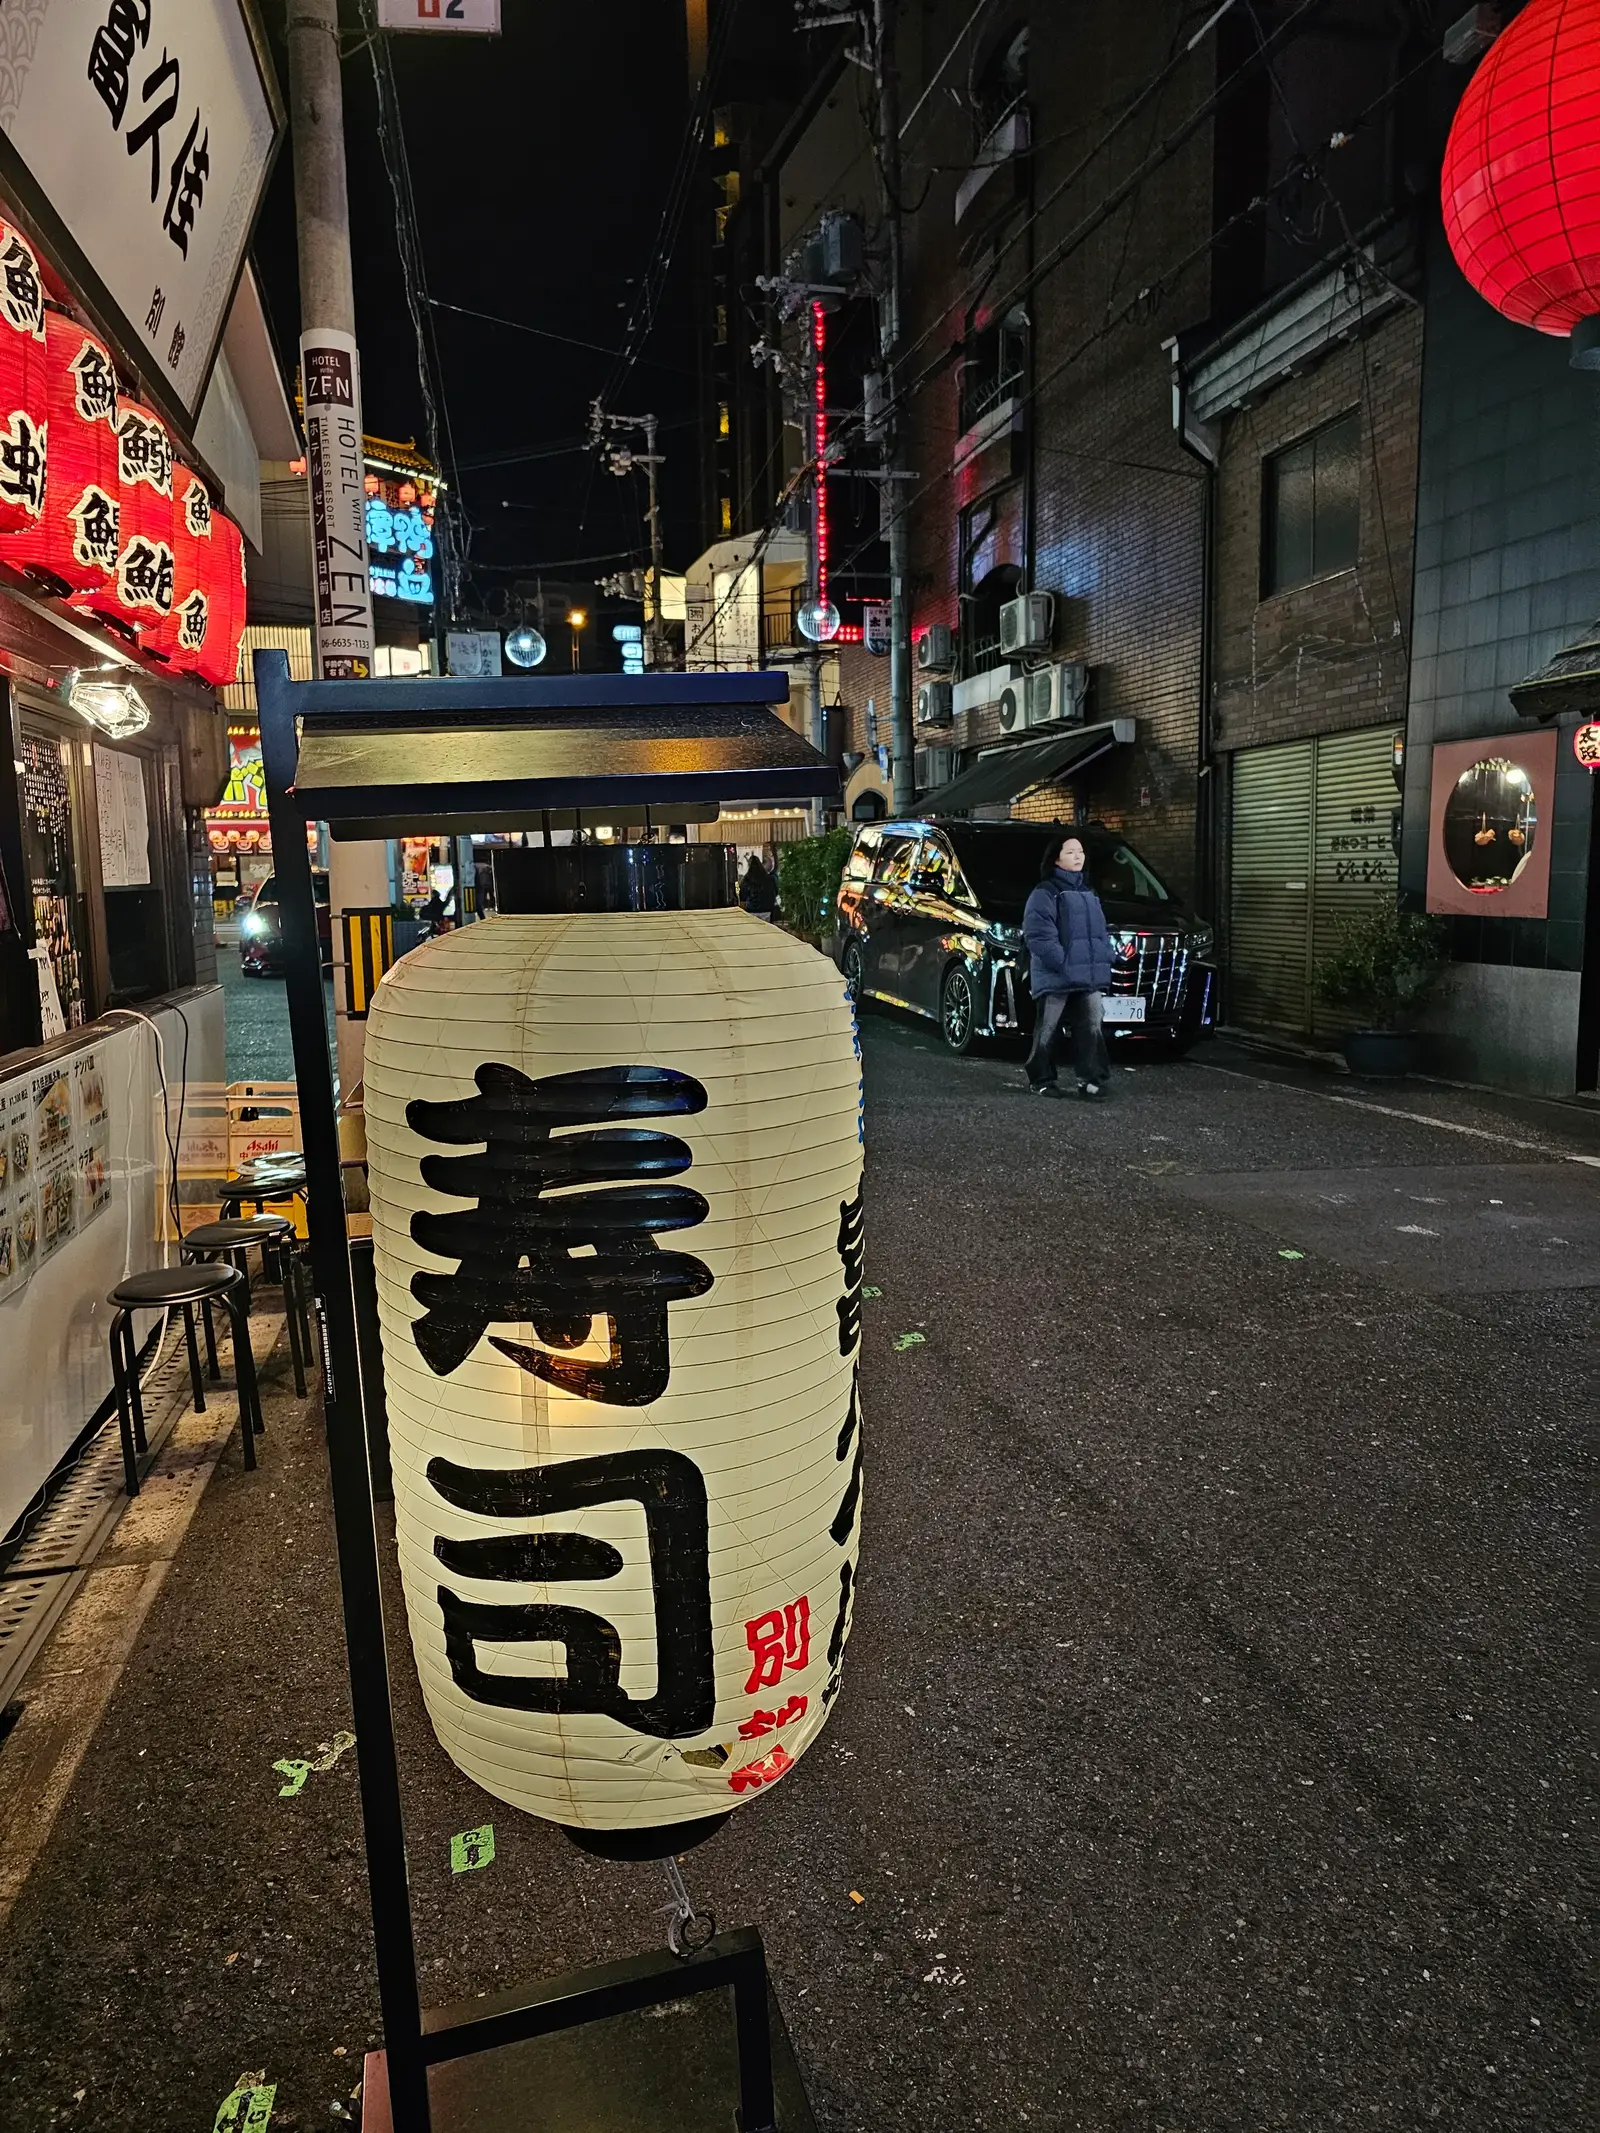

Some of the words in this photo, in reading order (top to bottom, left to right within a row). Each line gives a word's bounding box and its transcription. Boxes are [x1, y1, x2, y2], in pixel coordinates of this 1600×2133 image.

[312, 356, 341, 368] HOTEL
[308, 376, 350, 399] ZEN
[320, 416, 333, 477] TIMELESS
[337, 416, 359, 495] HOTEL
[324, 481, 336, 529] RESORT
[351, 500, 362, 532] WITH
[329, 535, 368, 629] ZEN
[321, 638, 370, 650] 06-6635-1133
[246, 1140, 279, 1151] Asahi
[404, 1063, 716, 1739] 寿司
